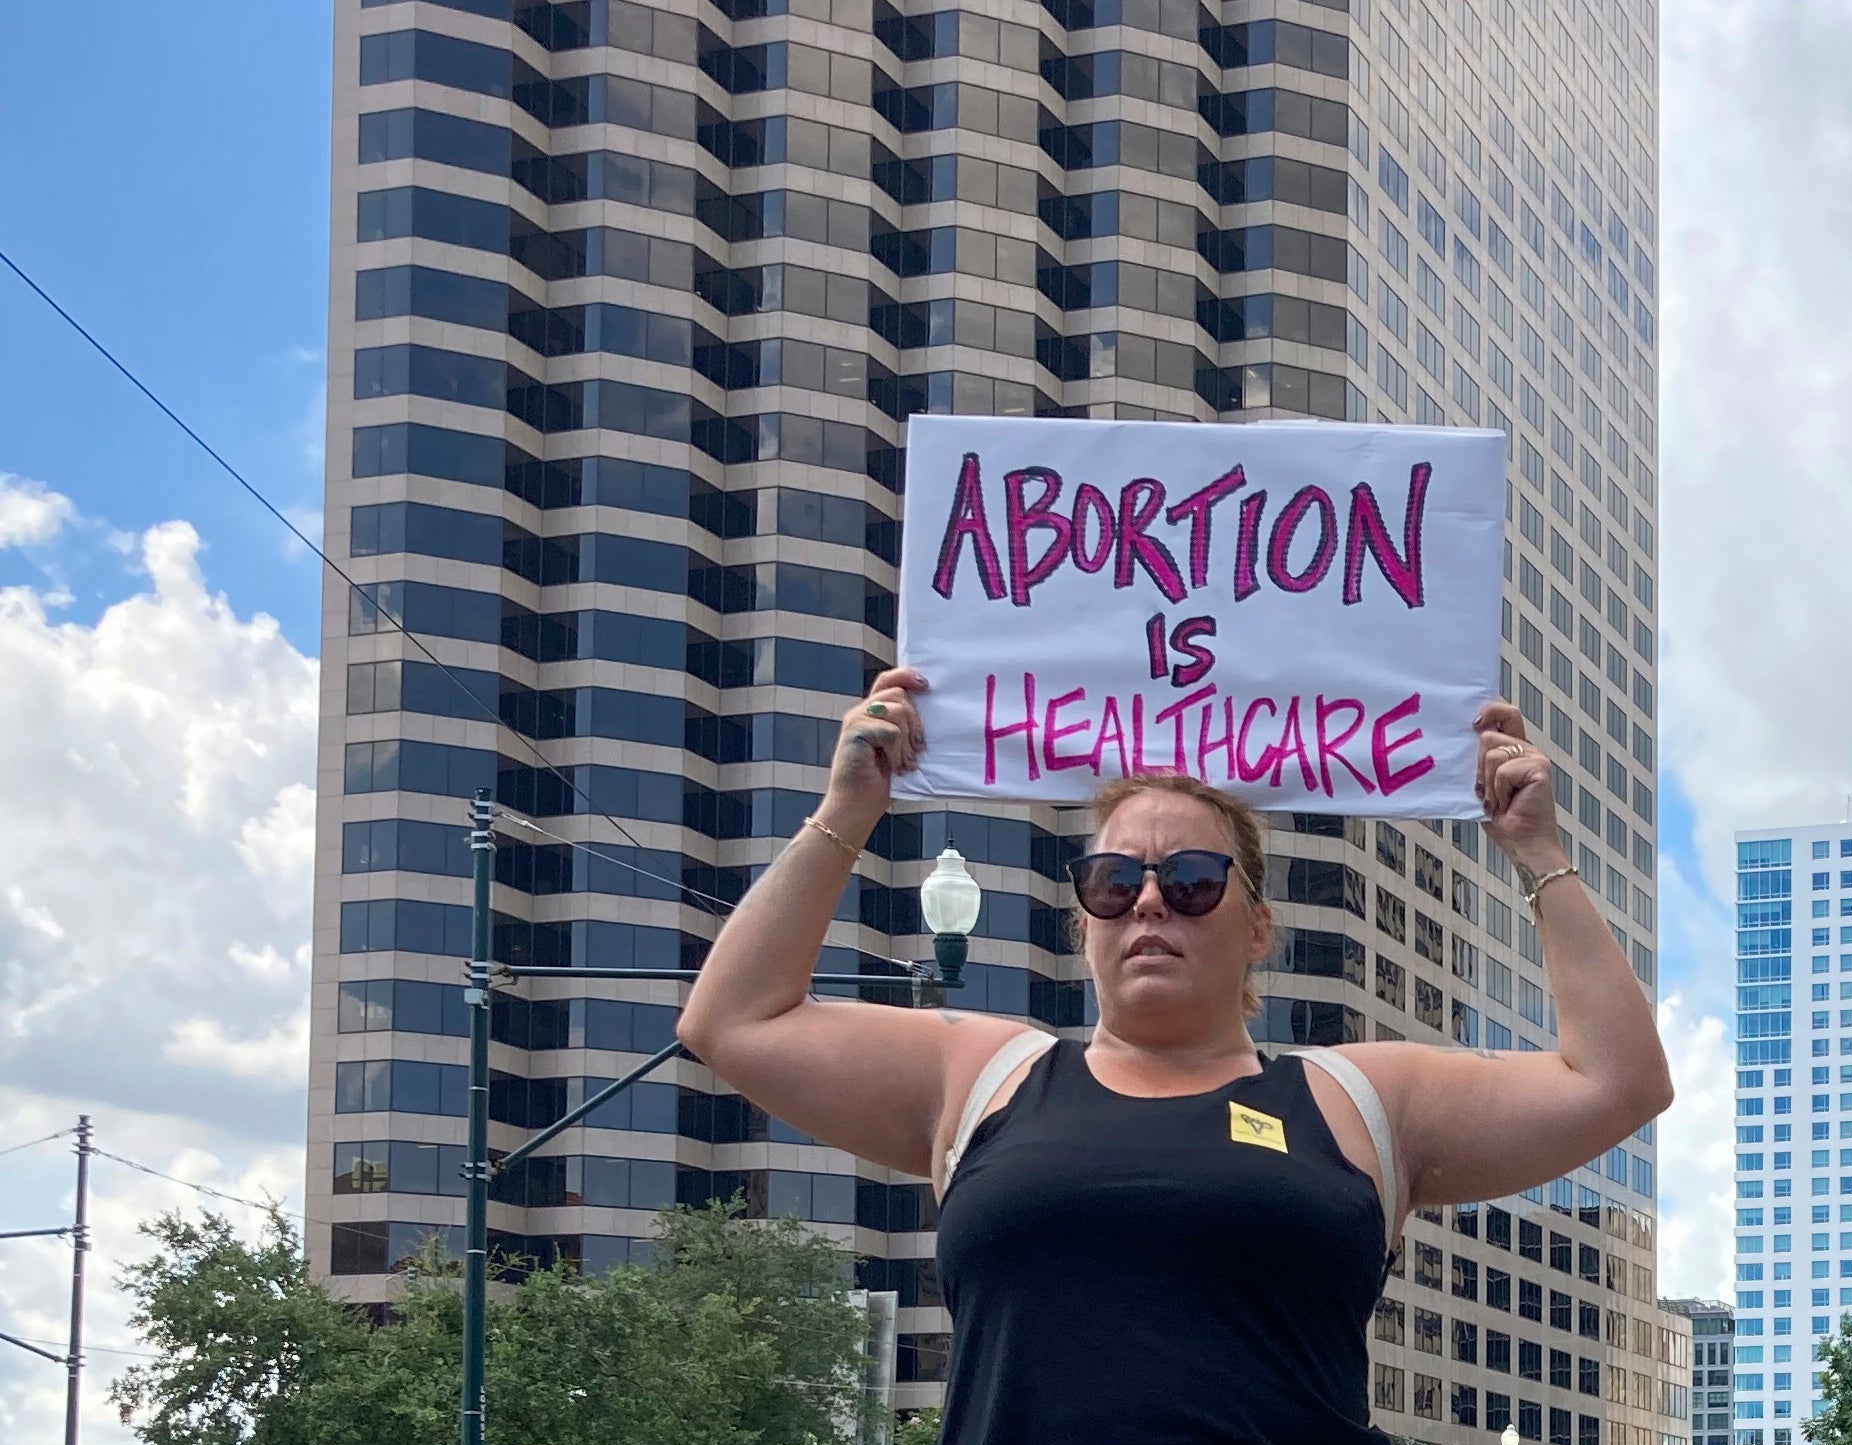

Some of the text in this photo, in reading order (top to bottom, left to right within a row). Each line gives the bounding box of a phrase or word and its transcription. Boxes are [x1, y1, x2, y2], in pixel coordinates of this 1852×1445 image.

[932, 452, 1433, 609] ABORTION
[1145, 611, 1218, 688] IS
[984, 672, 1436, 799] HEALTHCARE
